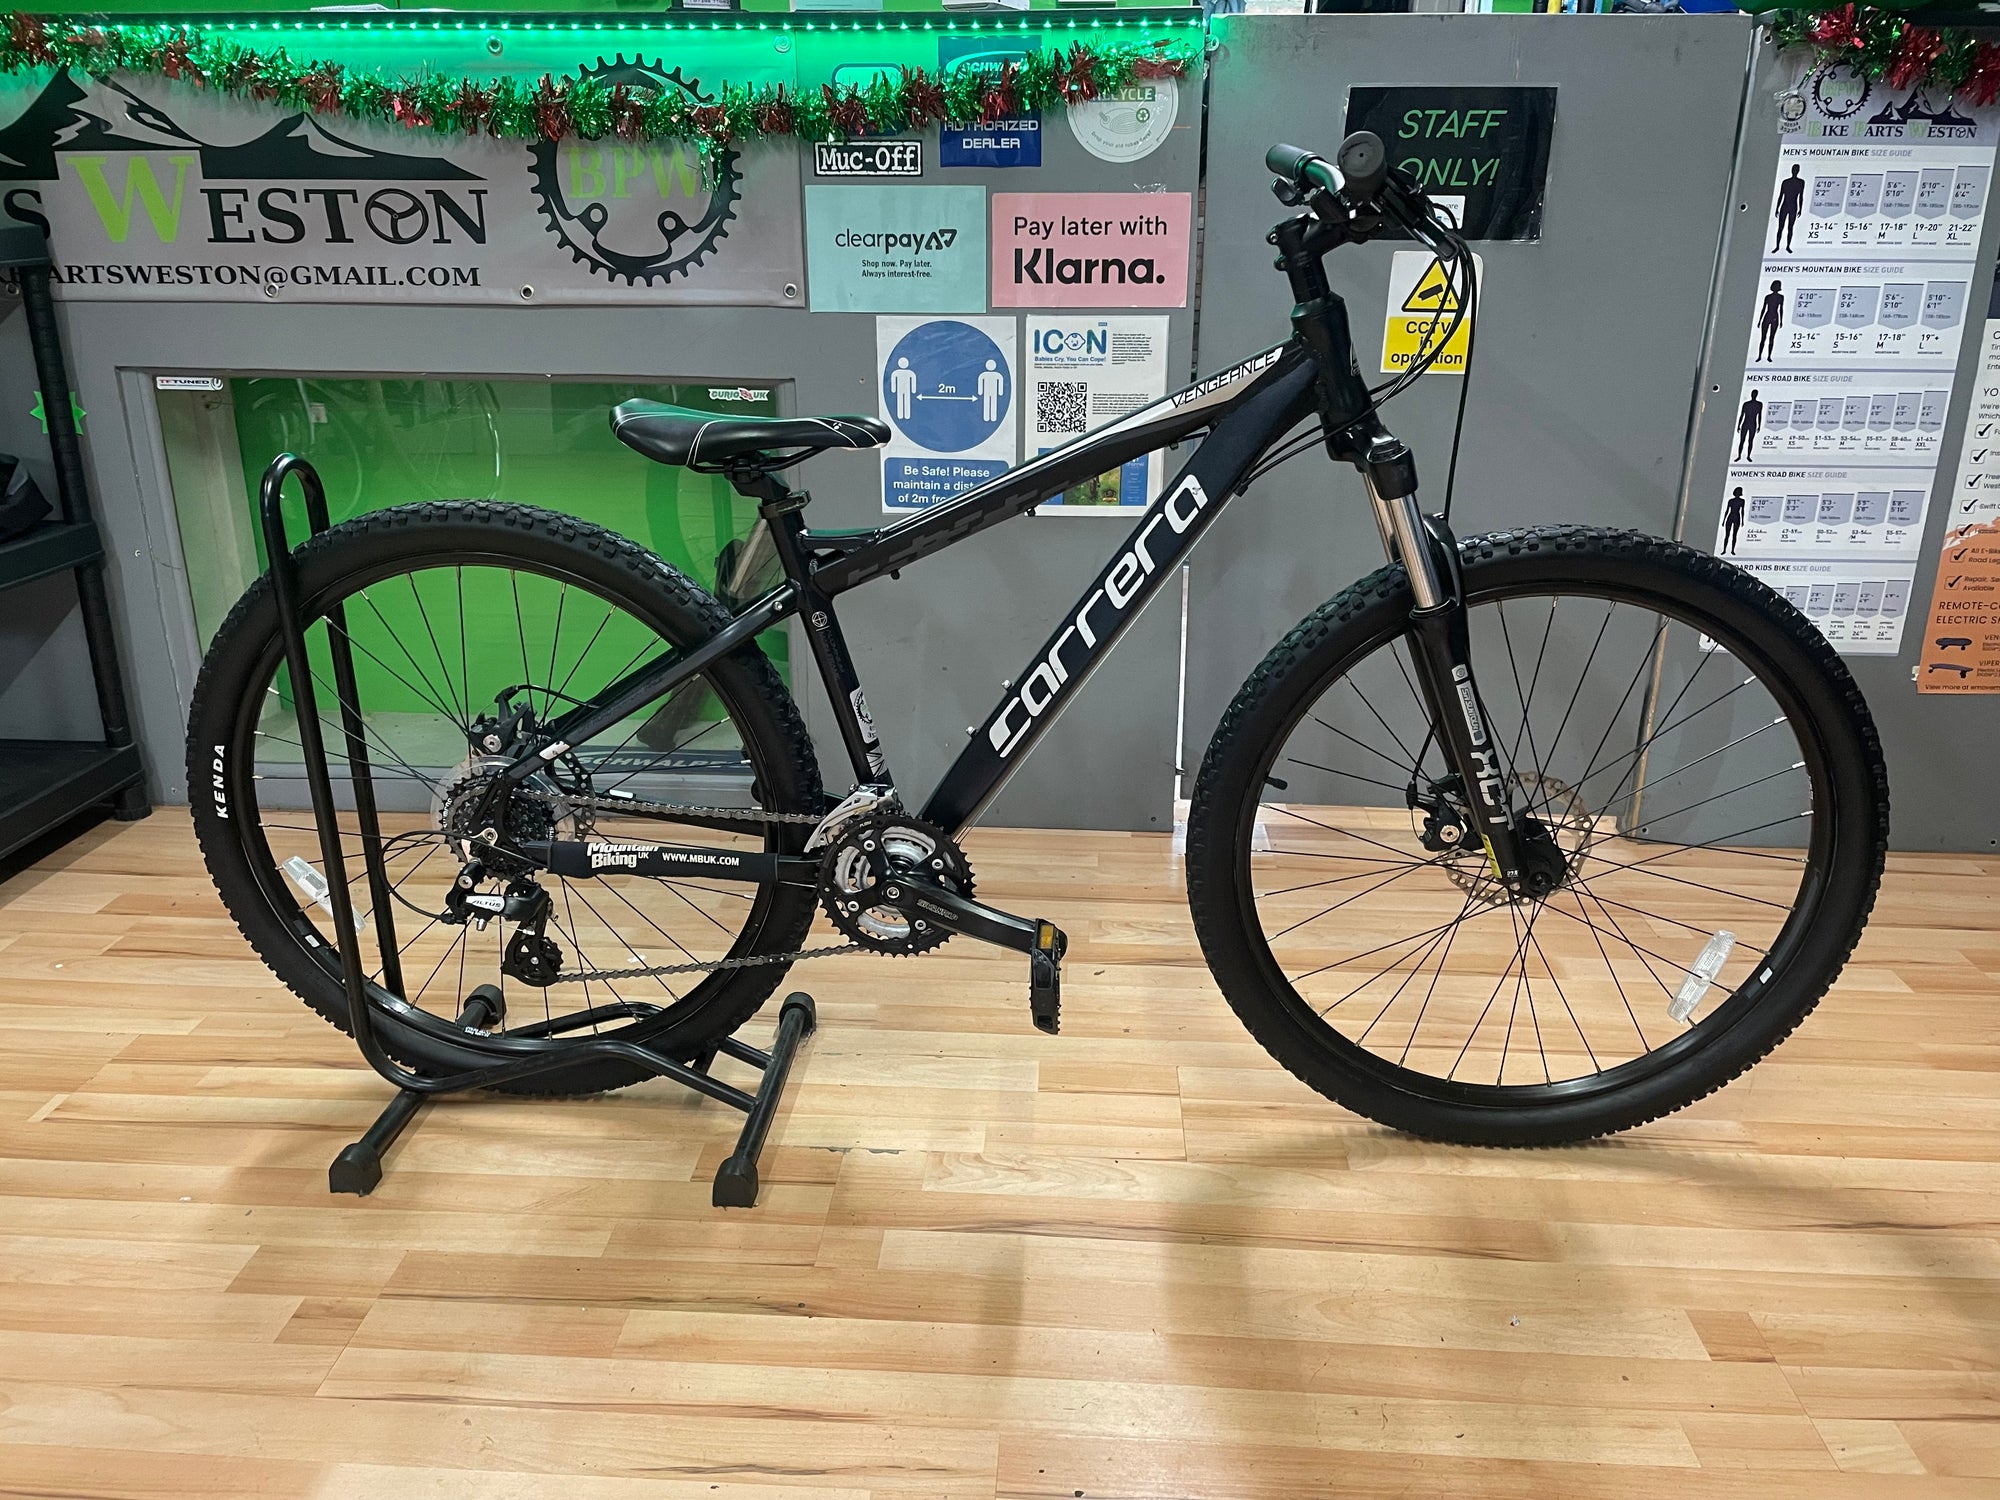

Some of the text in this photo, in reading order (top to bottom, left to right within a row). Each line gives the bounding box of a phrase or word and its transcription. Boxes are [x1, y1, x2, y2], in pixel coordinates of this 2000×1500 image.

[944, 120, 1038, 132] AUTHORIZED
[1398, 109, 1508, 139] STAFF
[1808, 121, 1849, 137] BIKE
[1852, 121, 1904, 138] PARTS
[962, 138, 1020, 149] DEALER
[820, 146, 915, 171] Muc-Off
[1783, 149, 1807, 157] MEN'S
[1810, 149, 1850, 157] MOUNTAIN
[1851, 149, 1870, 157] BIKE
[1889, 150, 1913, 158] GUIDE
[1397, 157, 1500, 187] ONLY!
[1014, 215, 1167, 240] Pay later with
[835, 228, 925, 255] clearpay
[1808, 231, 1958, 241] XS S M L XL
[862, 259, 932, 268] Shop now. Pay later.
[1014, 248, 1165, 285] Klarna.
[862, 270, 932, 279] Always interest-free.
[1764, 266, 1800, 274] WOMEN'S
[1802, 266, 1842, 274] MOUNTAIN
[1862, 266, 1879, 274] SIZE
[1881, 266, 1904, 274] GUIDE
[1790, 341, 1802, 349] XS
[1918, 342, 1924, 350] L
[1171, 353, 1276, 408] VENGEANCE
[1746, 375, 1770, 383] MEN'S
[1771, 375, 1792, 383] ROAD
[1794, 375, 1811, 383] BIKE
[938, 383, 956, 394] 2m
[904, 465, 990, 478] Be Safe! Please
[893, 480, 941, 491] maintain
[898, 494, 929, 503] of 2m
[989, 474, 1208, 758] carrera
[1936, 616, 1987, 624] ELECTRIC
[212, 745, 229, 819] KENDA
[591, 853, 637, 868] Biking
[662, 853, 739, 866] WWW.MBUK.COM
